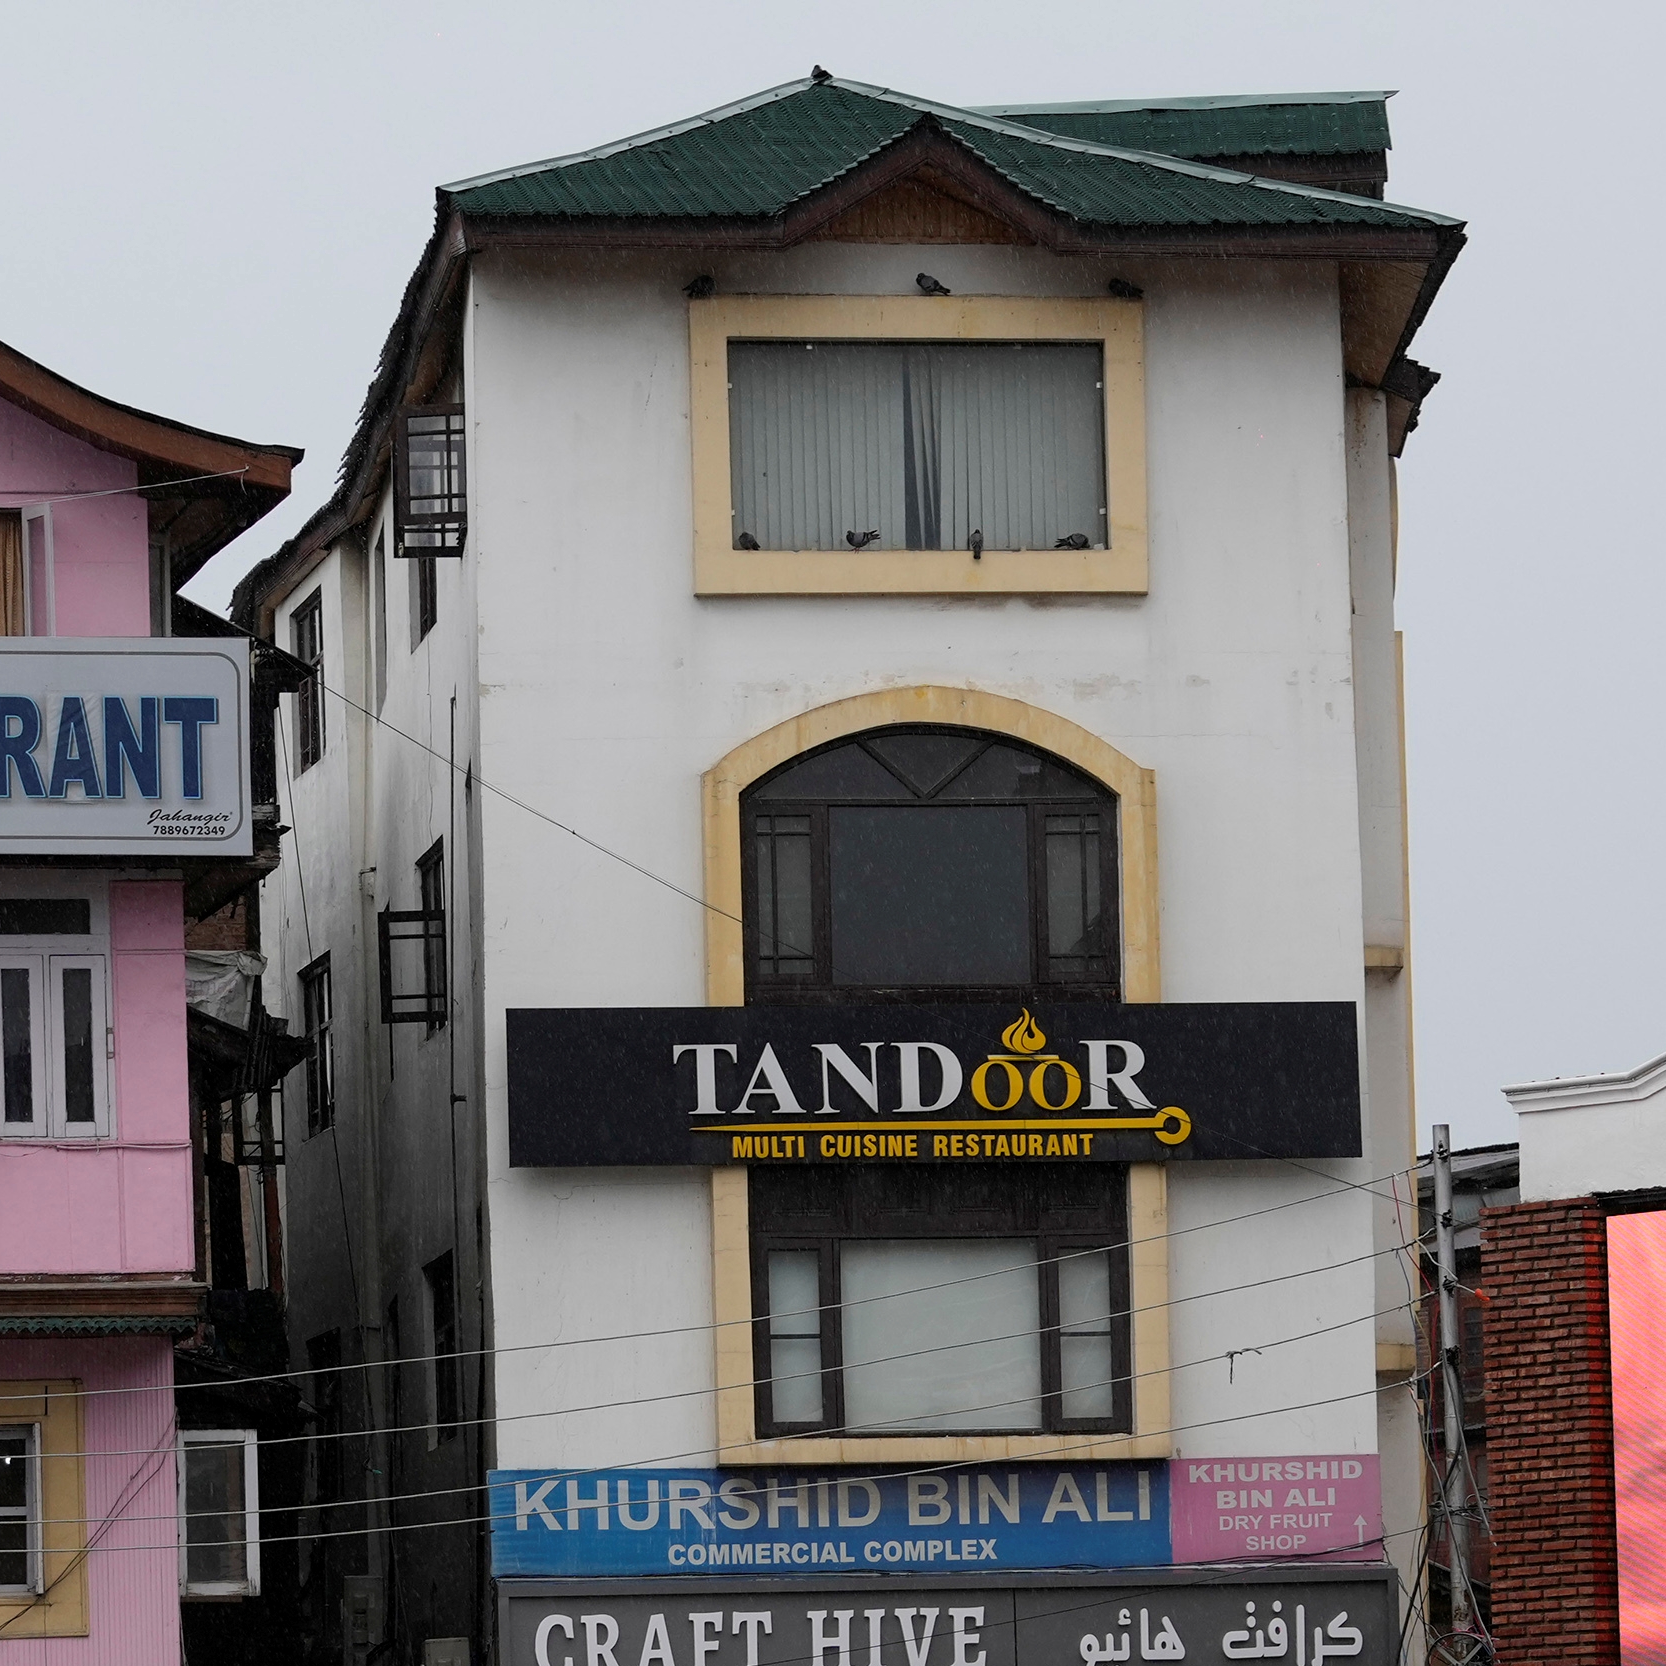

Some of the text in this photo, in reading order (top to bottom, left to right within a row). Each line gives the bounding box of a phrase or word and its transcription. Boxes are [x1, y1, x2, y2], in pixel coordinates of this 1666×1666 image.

[147, 809, 232, 825] Jahangir
[153, 826, 225, 835] 7889672349
[673, 1039, 1157, 1115] TANDOOR
[732, 1132, 1093, 1157] MULTI CUISINE RESTAURANT
[1189, 1460, 1363, 1483] KHURSHID
[515, 1470, 1151, 1531] KHURSHID BIN ALI
[1216, 1488, 1336, 1509] BIN ALI
[1219, 1512, 1333, 1531] DRY FRUIT
[668, 1538, 997, 1566] COMMERCIAL COMPLEX
[1246, 1535, 1307, 1552] SHOP
